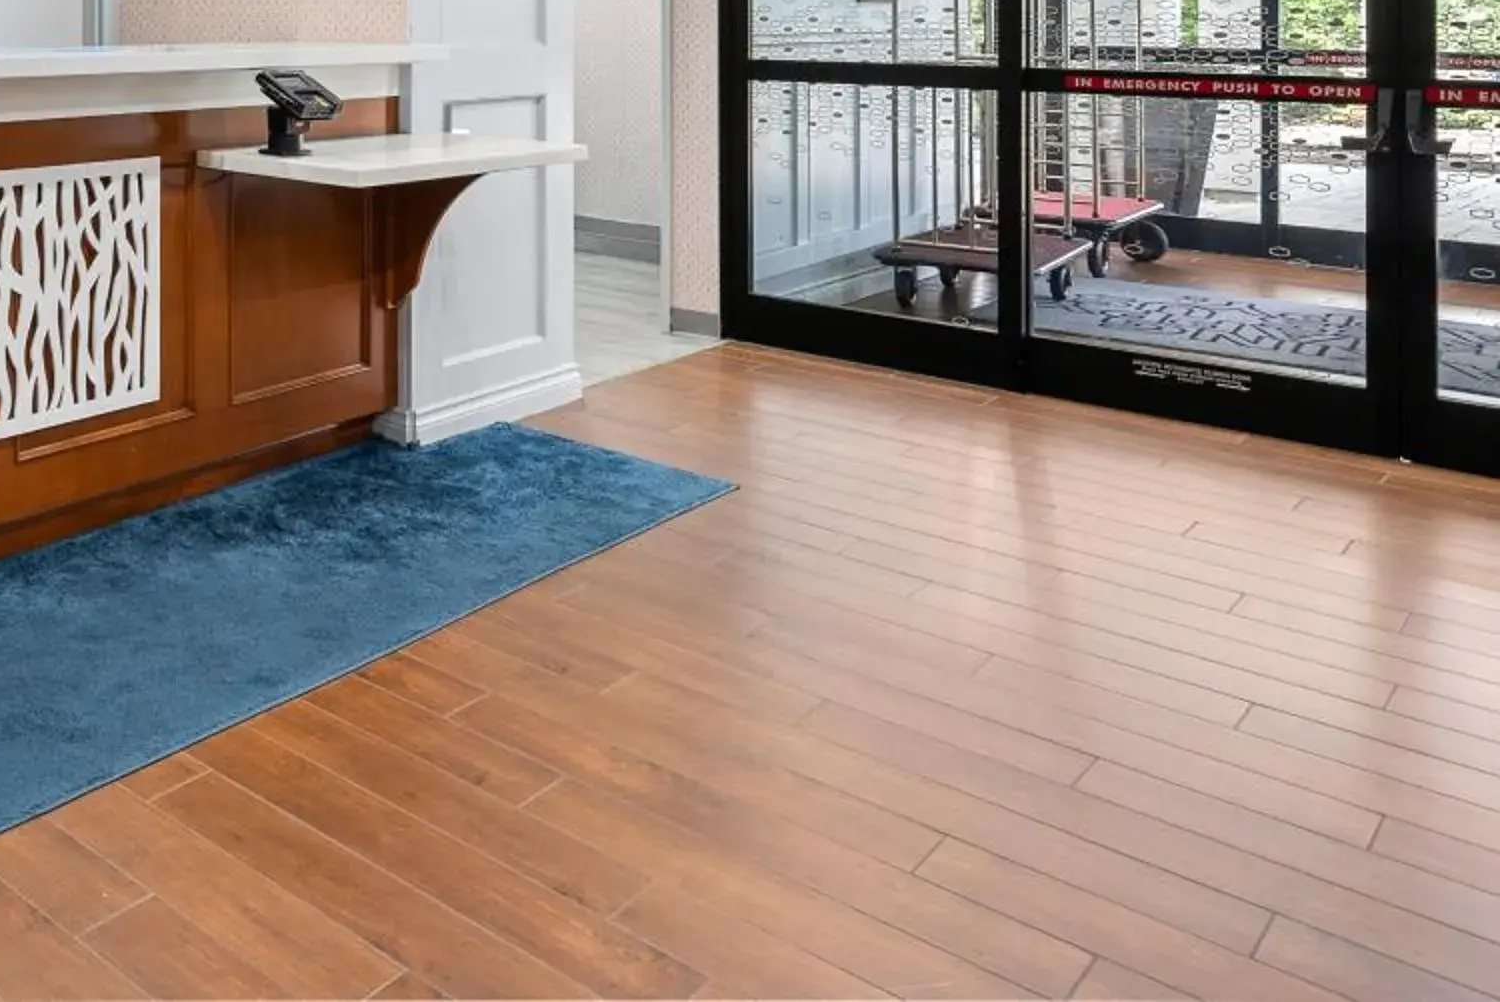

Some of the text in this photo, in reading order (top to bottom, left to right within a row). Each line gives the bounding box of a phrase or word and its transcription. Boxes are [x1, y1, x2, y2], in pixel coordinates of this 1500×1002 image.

[1074, 77, 1362, 98] IN EMERGENCY PUSH TO OPEN
[1439, 88, 1463, 102] IN
